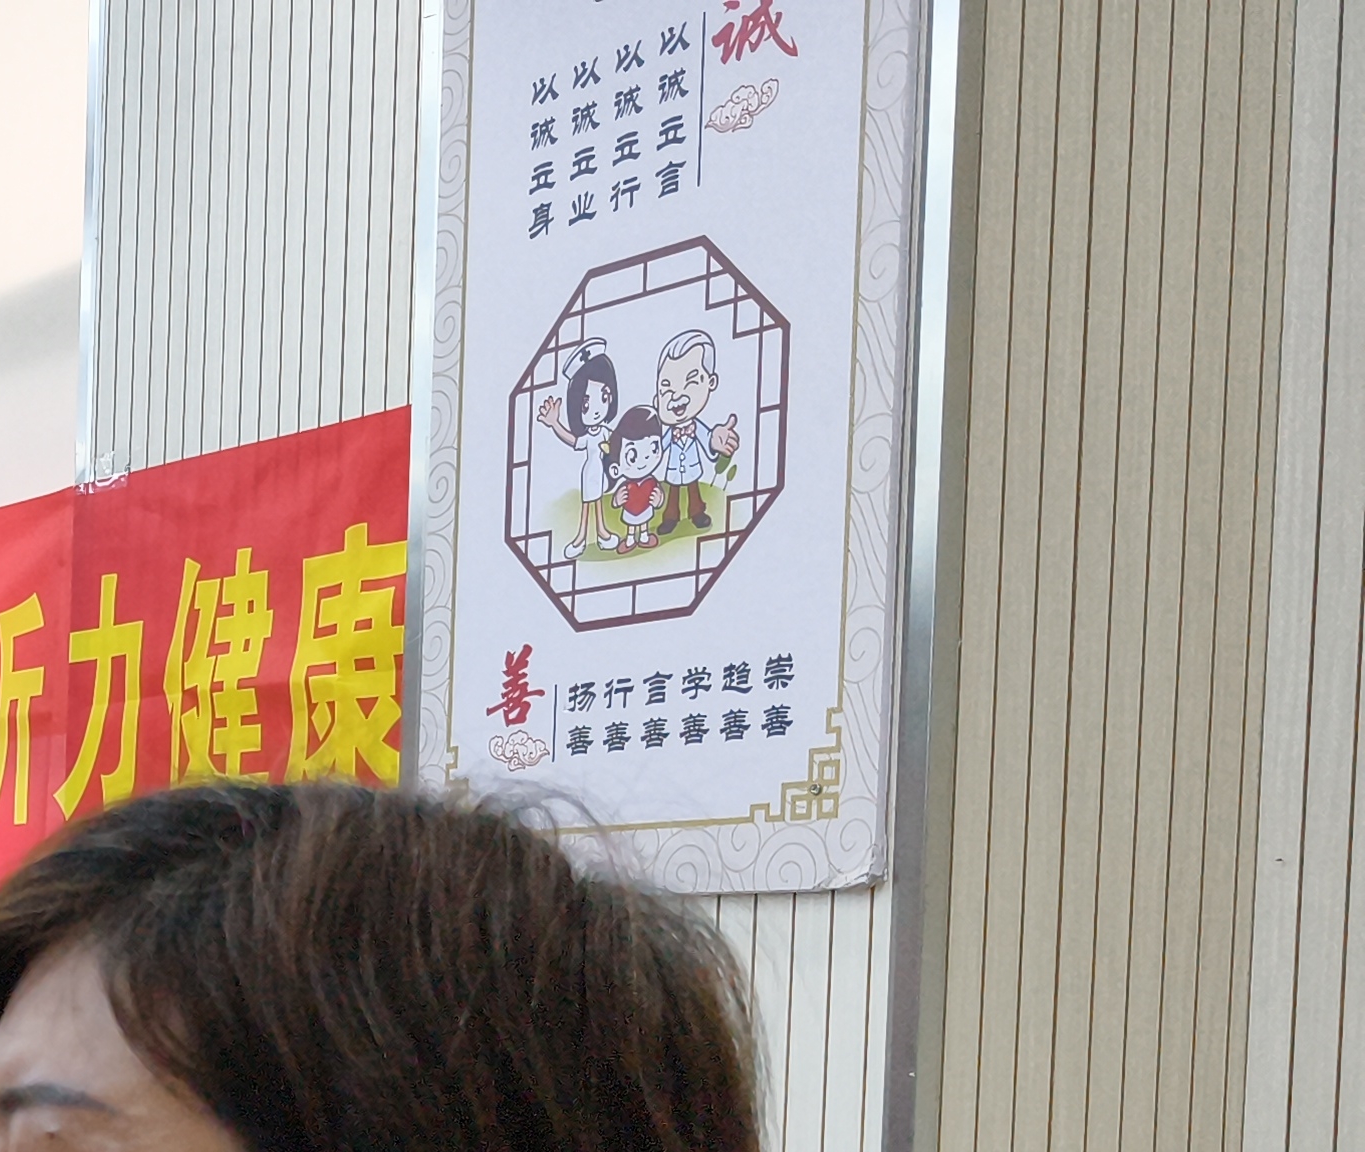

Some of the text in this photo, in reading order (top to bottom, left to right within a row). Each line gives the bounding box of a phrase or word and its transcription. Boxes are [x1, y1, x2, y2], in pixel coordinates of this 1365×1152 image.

[655, 21, 690, 199] 以诚立言
[711, 0, 799, 65] 诚
[528, 73, 559, 240] 以诚立身
[568, 56, 601, 226] 以诚立业
[609, 39, 645, 212] 以诚立行
[486, 644, 546, 728] 善
